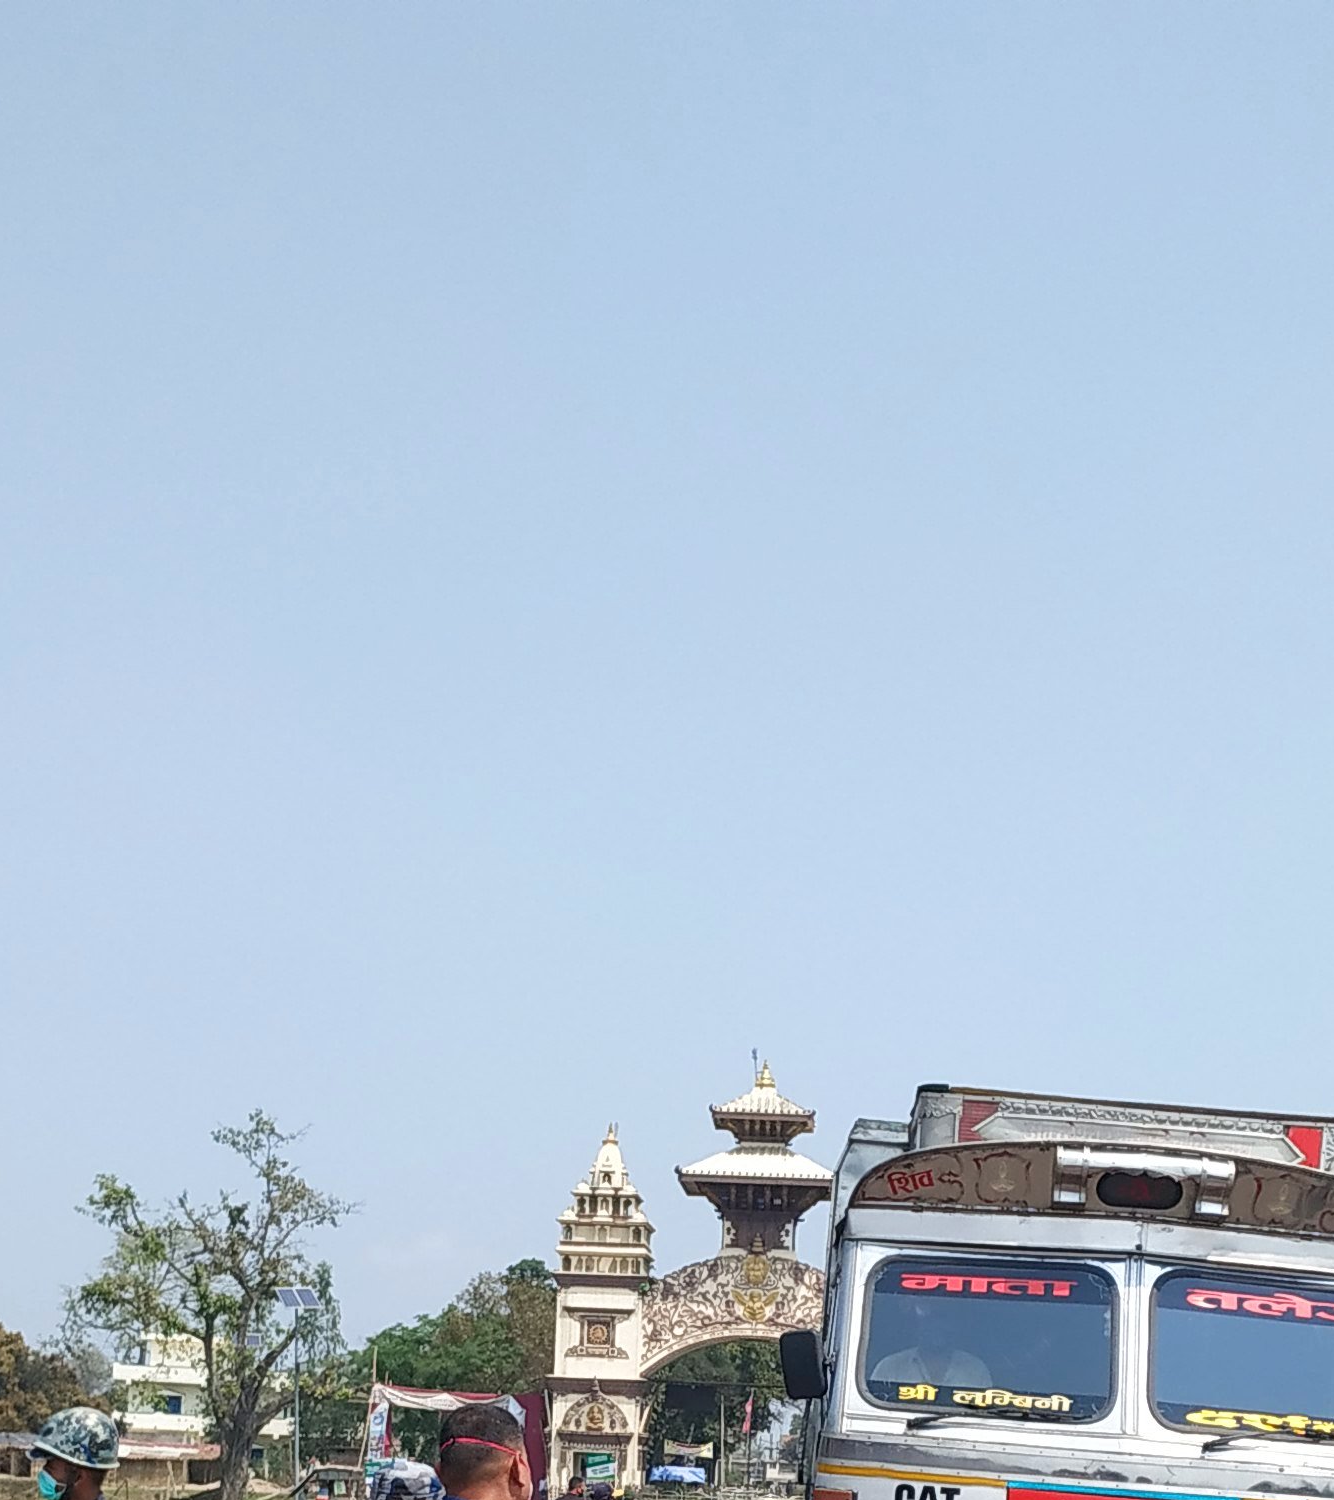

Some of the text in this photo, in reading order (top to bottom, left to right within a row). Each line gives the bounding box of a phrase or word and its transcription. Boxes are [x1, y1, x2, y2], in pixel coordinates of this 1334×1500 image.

[887, 1169, 935, 1195] शिव
[900, 1273, 1079, 1297] माता
[898, 1384, 939, 1401] श्री
